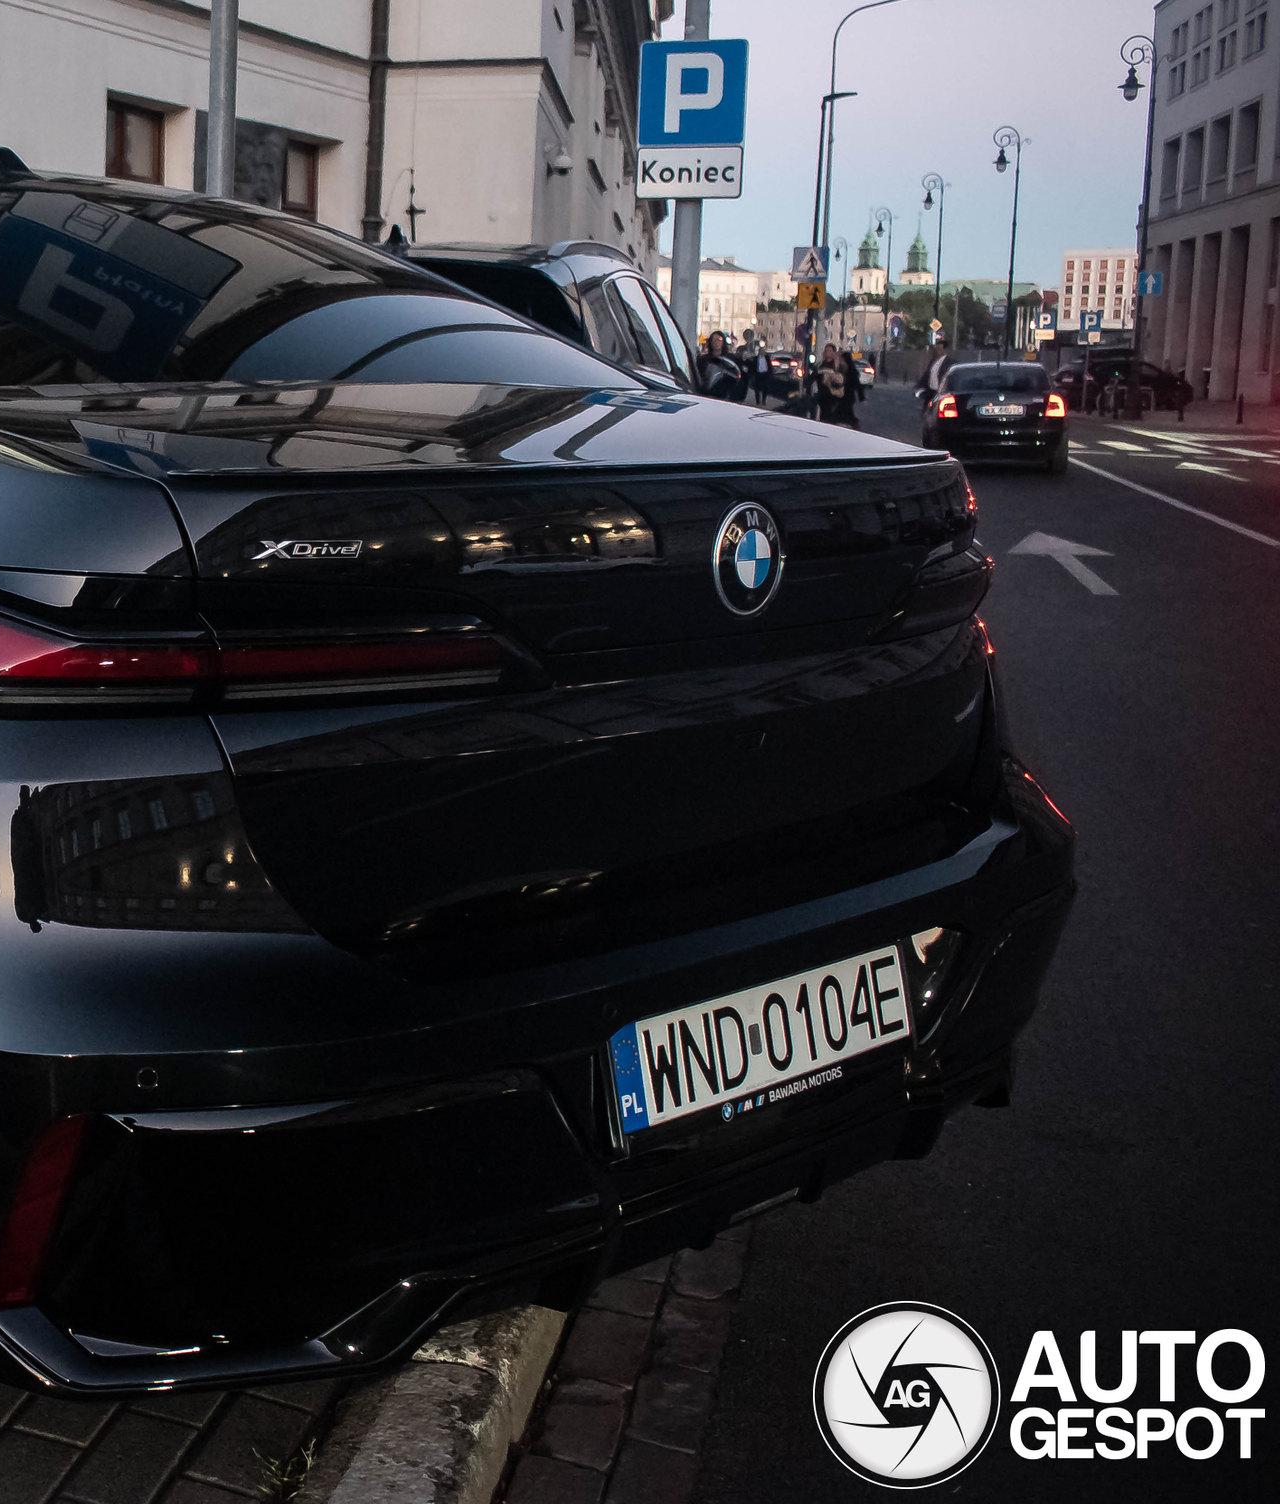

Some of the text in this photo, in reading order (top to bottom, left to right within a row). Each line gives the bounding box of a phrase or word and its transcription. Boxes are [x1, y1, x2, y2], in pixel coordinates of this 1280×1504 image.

[664, 52, 724, 133] P
[641, 159, 735, 183] Koniec
[1040, 313, 1052, 329] P
[1085, 314, 1097, 330] P
[726, 510, 776, 543] BMW
[641, 955, 904, 1114] WND 0104E
[768, 1079, 808, 1102] BAWARIA
[808, 1066, 843, 1089] MOTORS
[621, 1092, 643, 1117] PL
